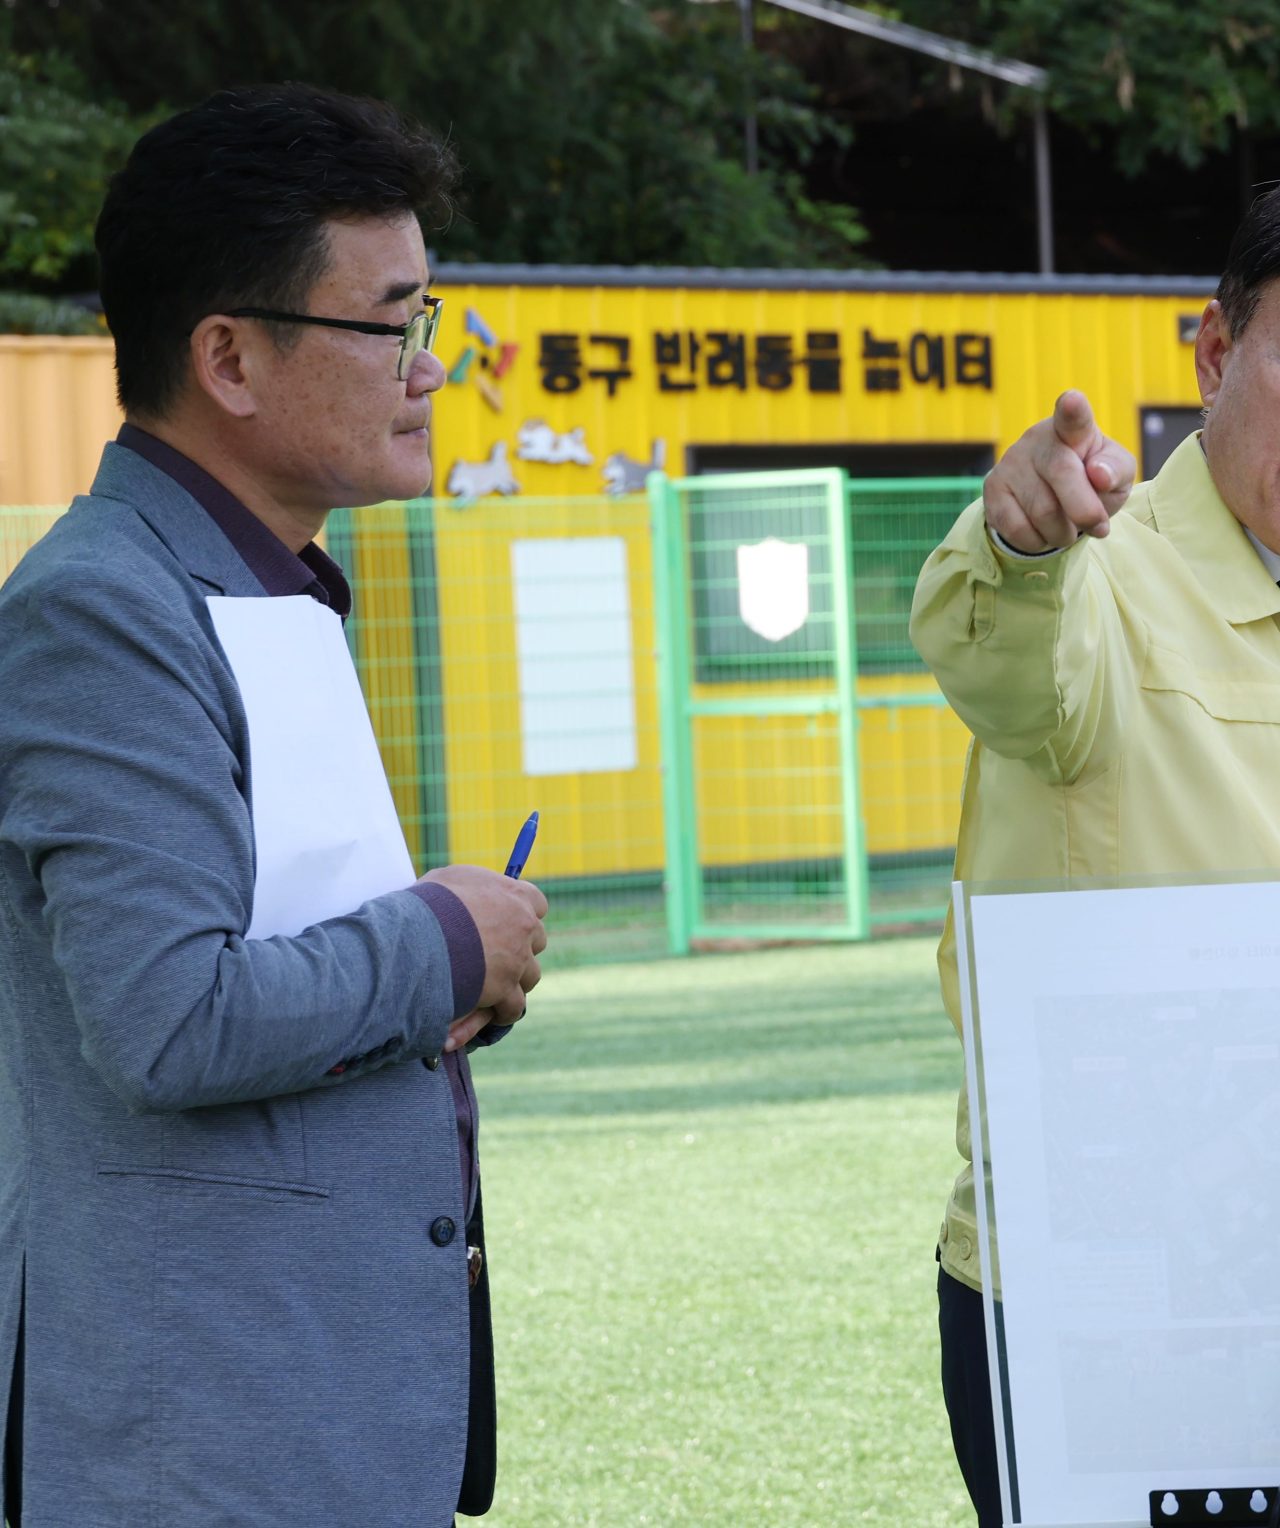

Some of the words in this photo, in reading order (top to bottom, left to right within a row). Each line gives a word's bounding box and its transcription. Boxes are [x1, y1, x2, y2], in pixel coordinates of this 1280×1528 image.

[537, 330, 633, 397] 동구
[654, 329, 843, 394] 반려동물
[862, 327, 994, 392] 놀이터
